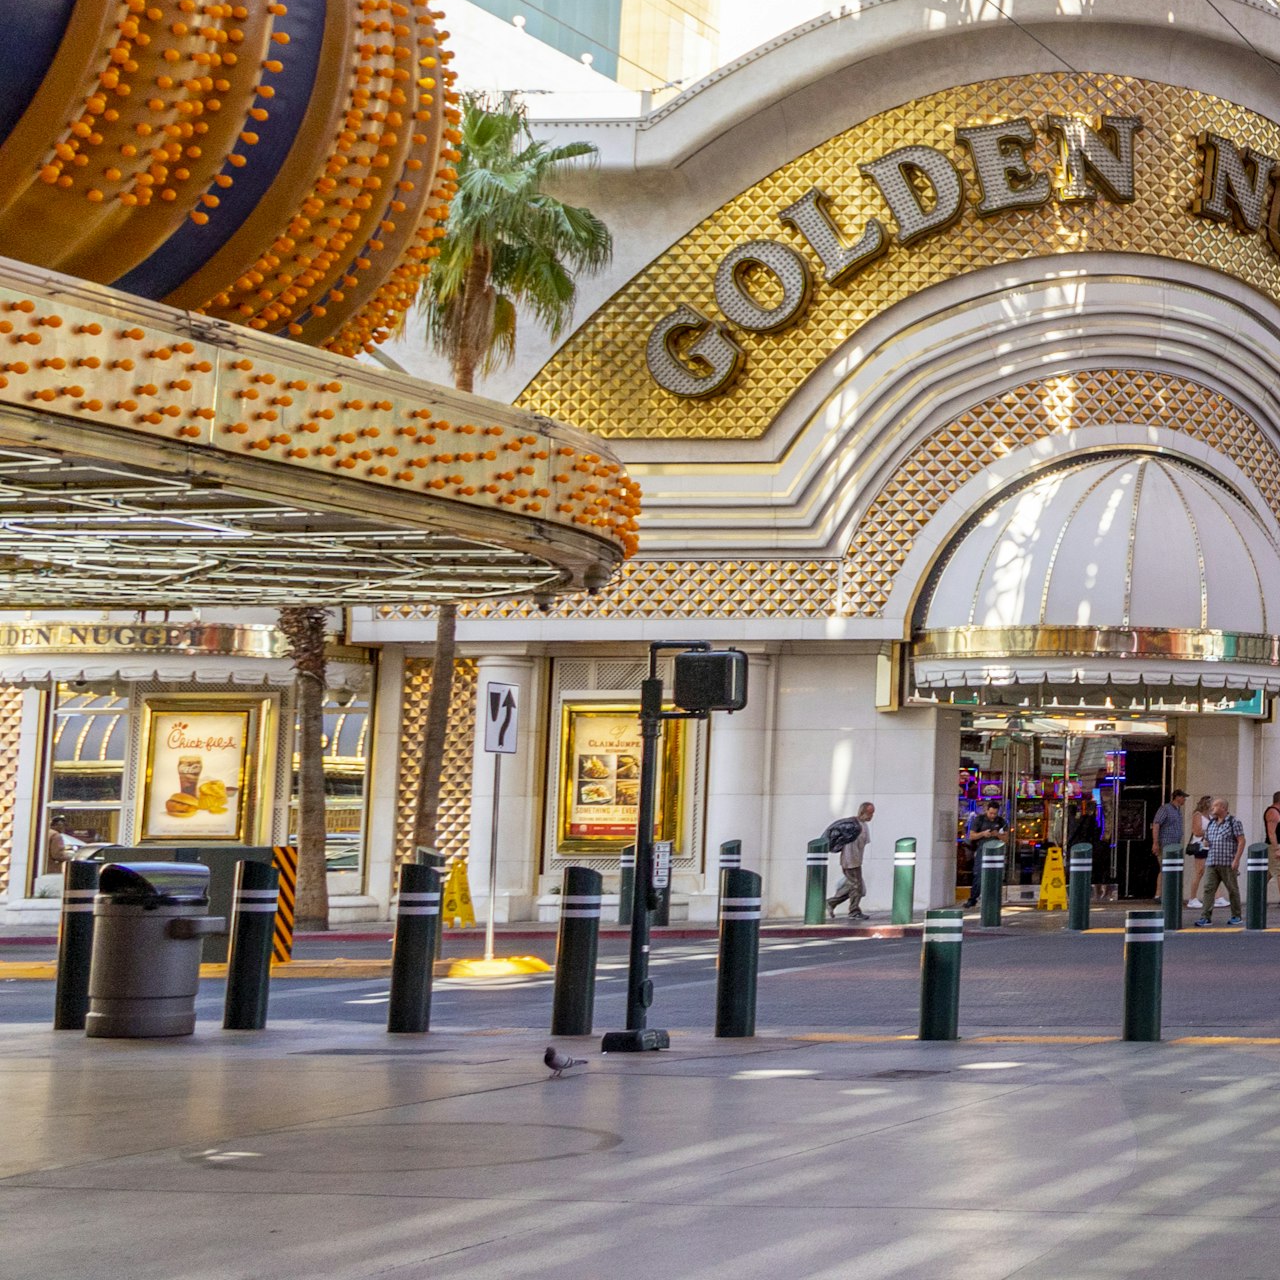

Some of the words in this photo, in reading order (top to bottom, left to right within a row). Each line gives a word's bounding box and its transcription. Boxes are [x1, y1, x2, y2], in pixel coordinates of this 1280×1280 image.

[646, 113, 1144, 400] GOLDEN
[69, 626, 206, 647] NUGGET
[167, 726, 237, 751] Chick-fil-A
[621, 806, 637, 814] EVER
